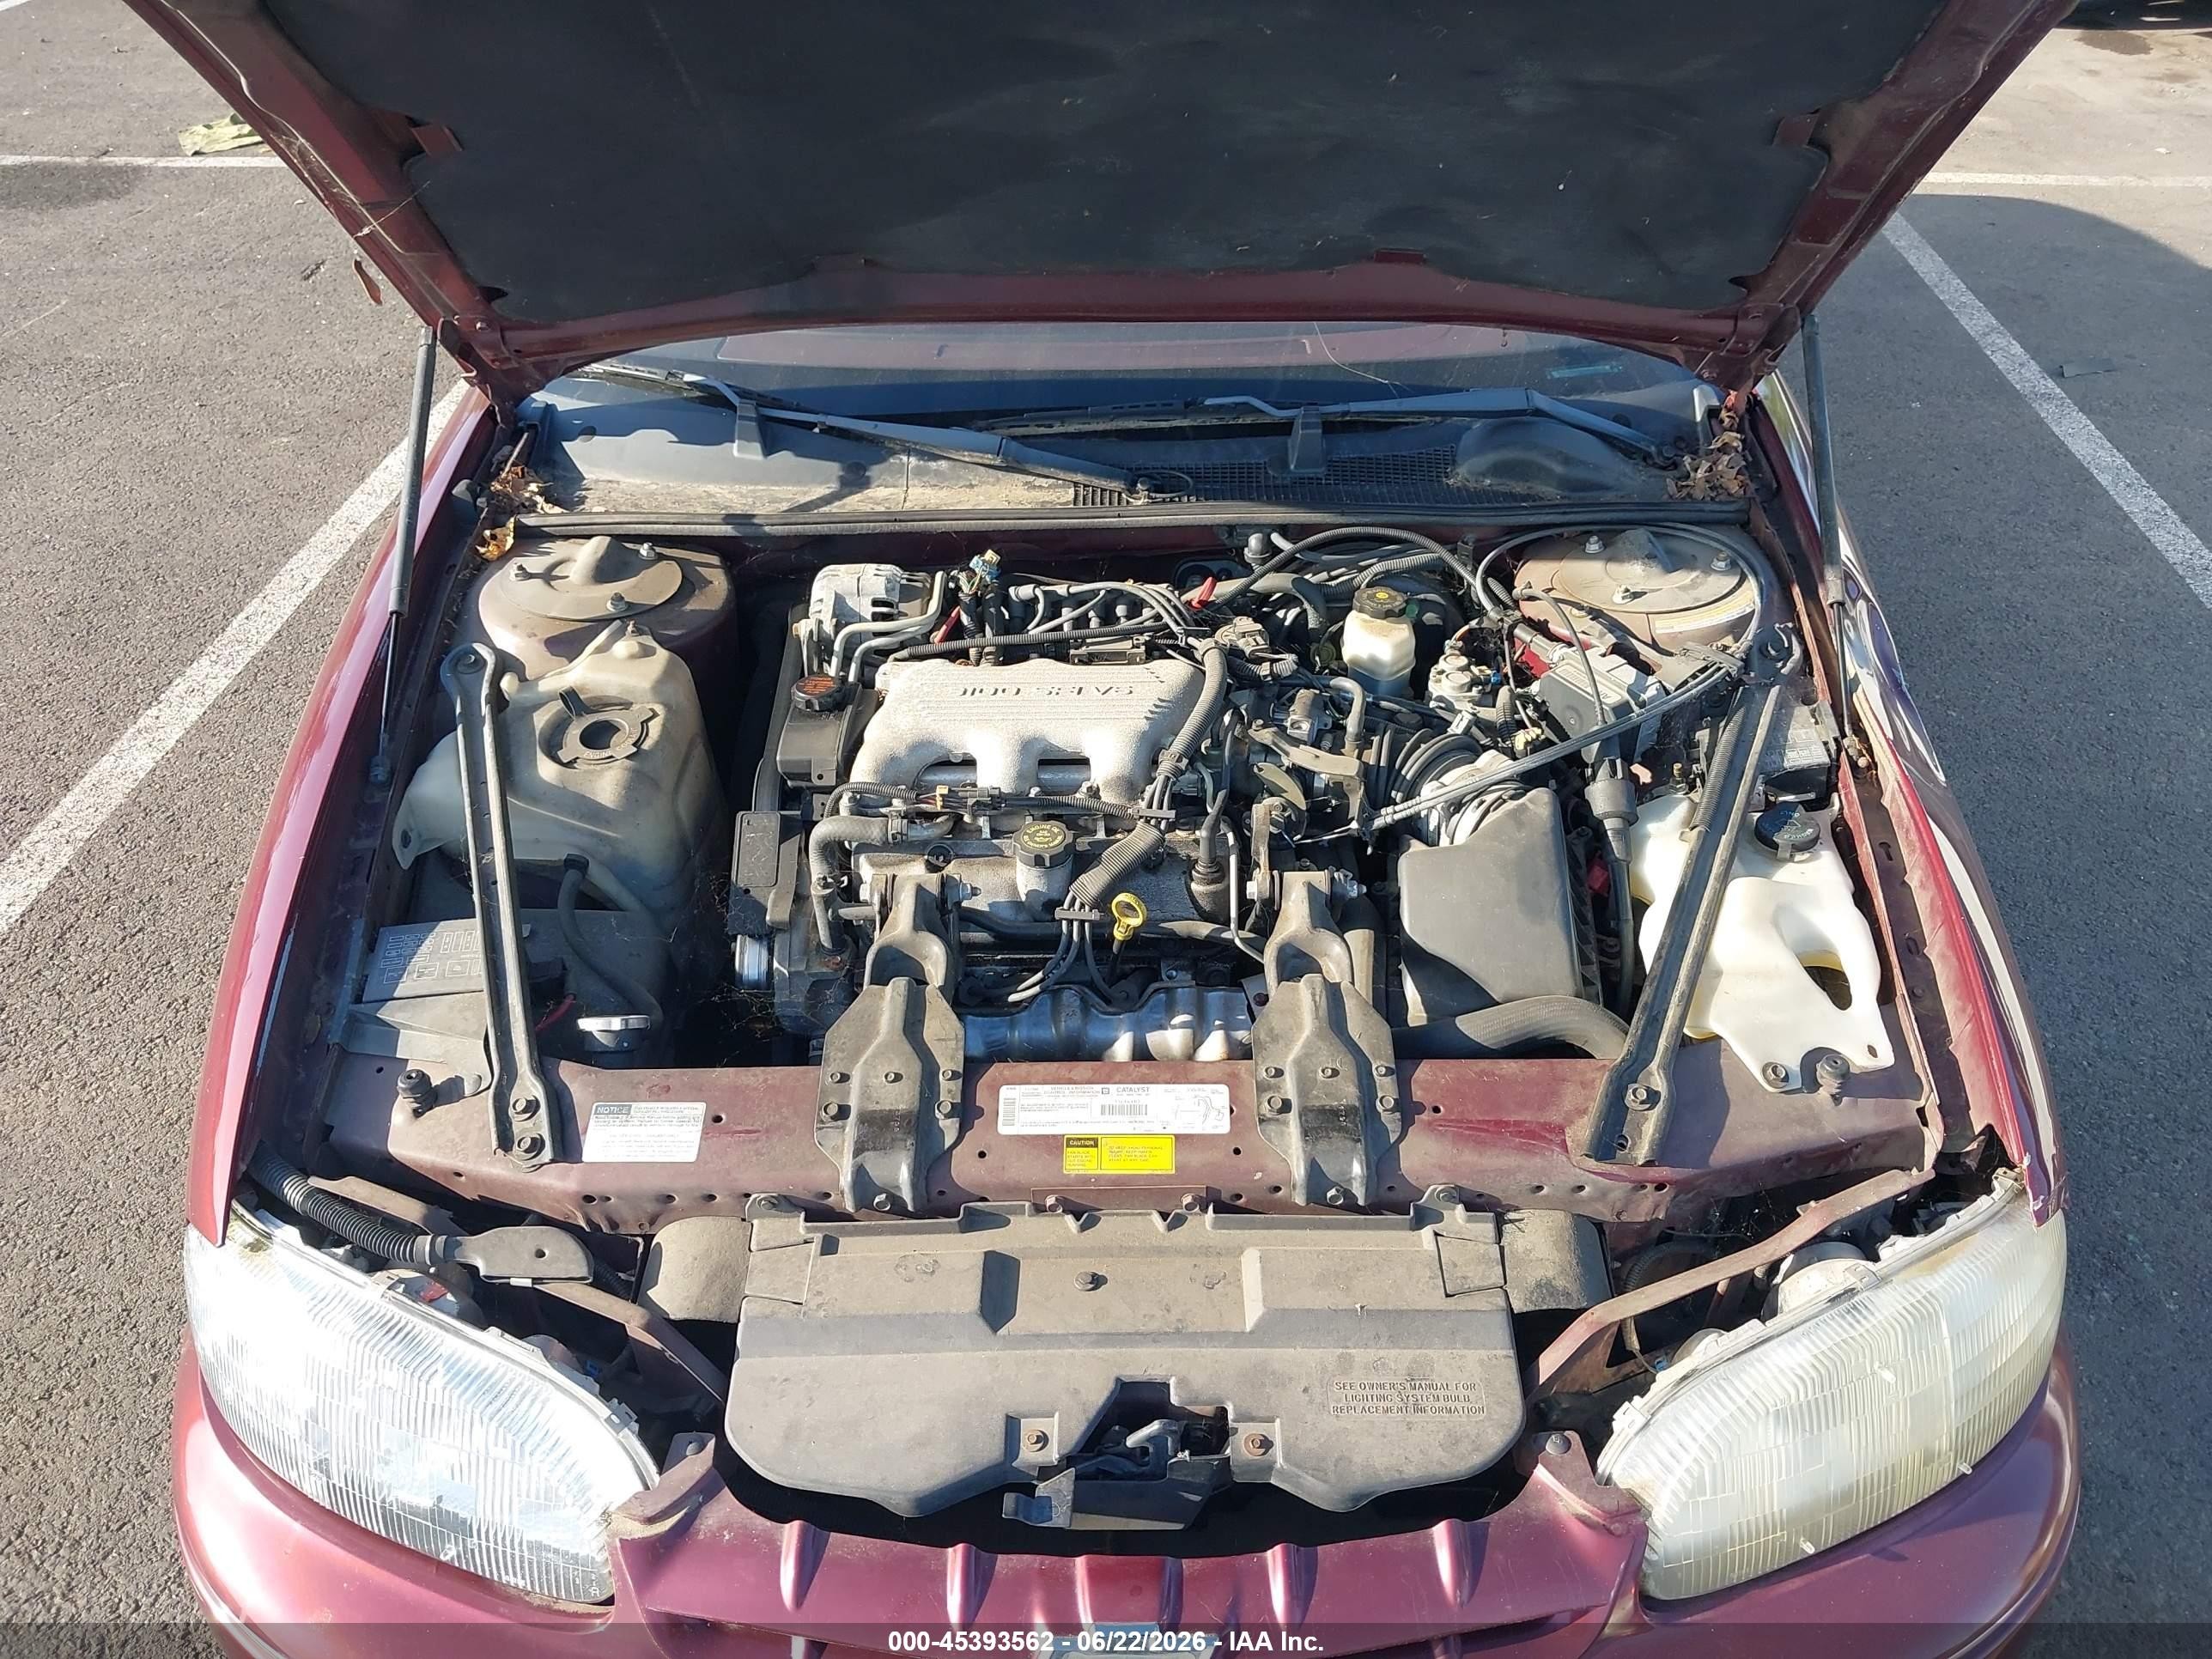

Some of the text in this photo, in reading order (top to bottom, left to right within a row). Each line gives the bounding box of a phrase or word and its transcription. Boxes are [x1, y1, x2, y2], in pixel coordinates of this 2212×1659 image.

[1334, 1382, 1477, 1391] SEE OWNER'S MANUAL FOR
[1345, 1394, 1471, 1403] LIGHTING SYSTEM BULB
[1332, 1405, 1486, 1415] REPLACEMENT INFORMATION
